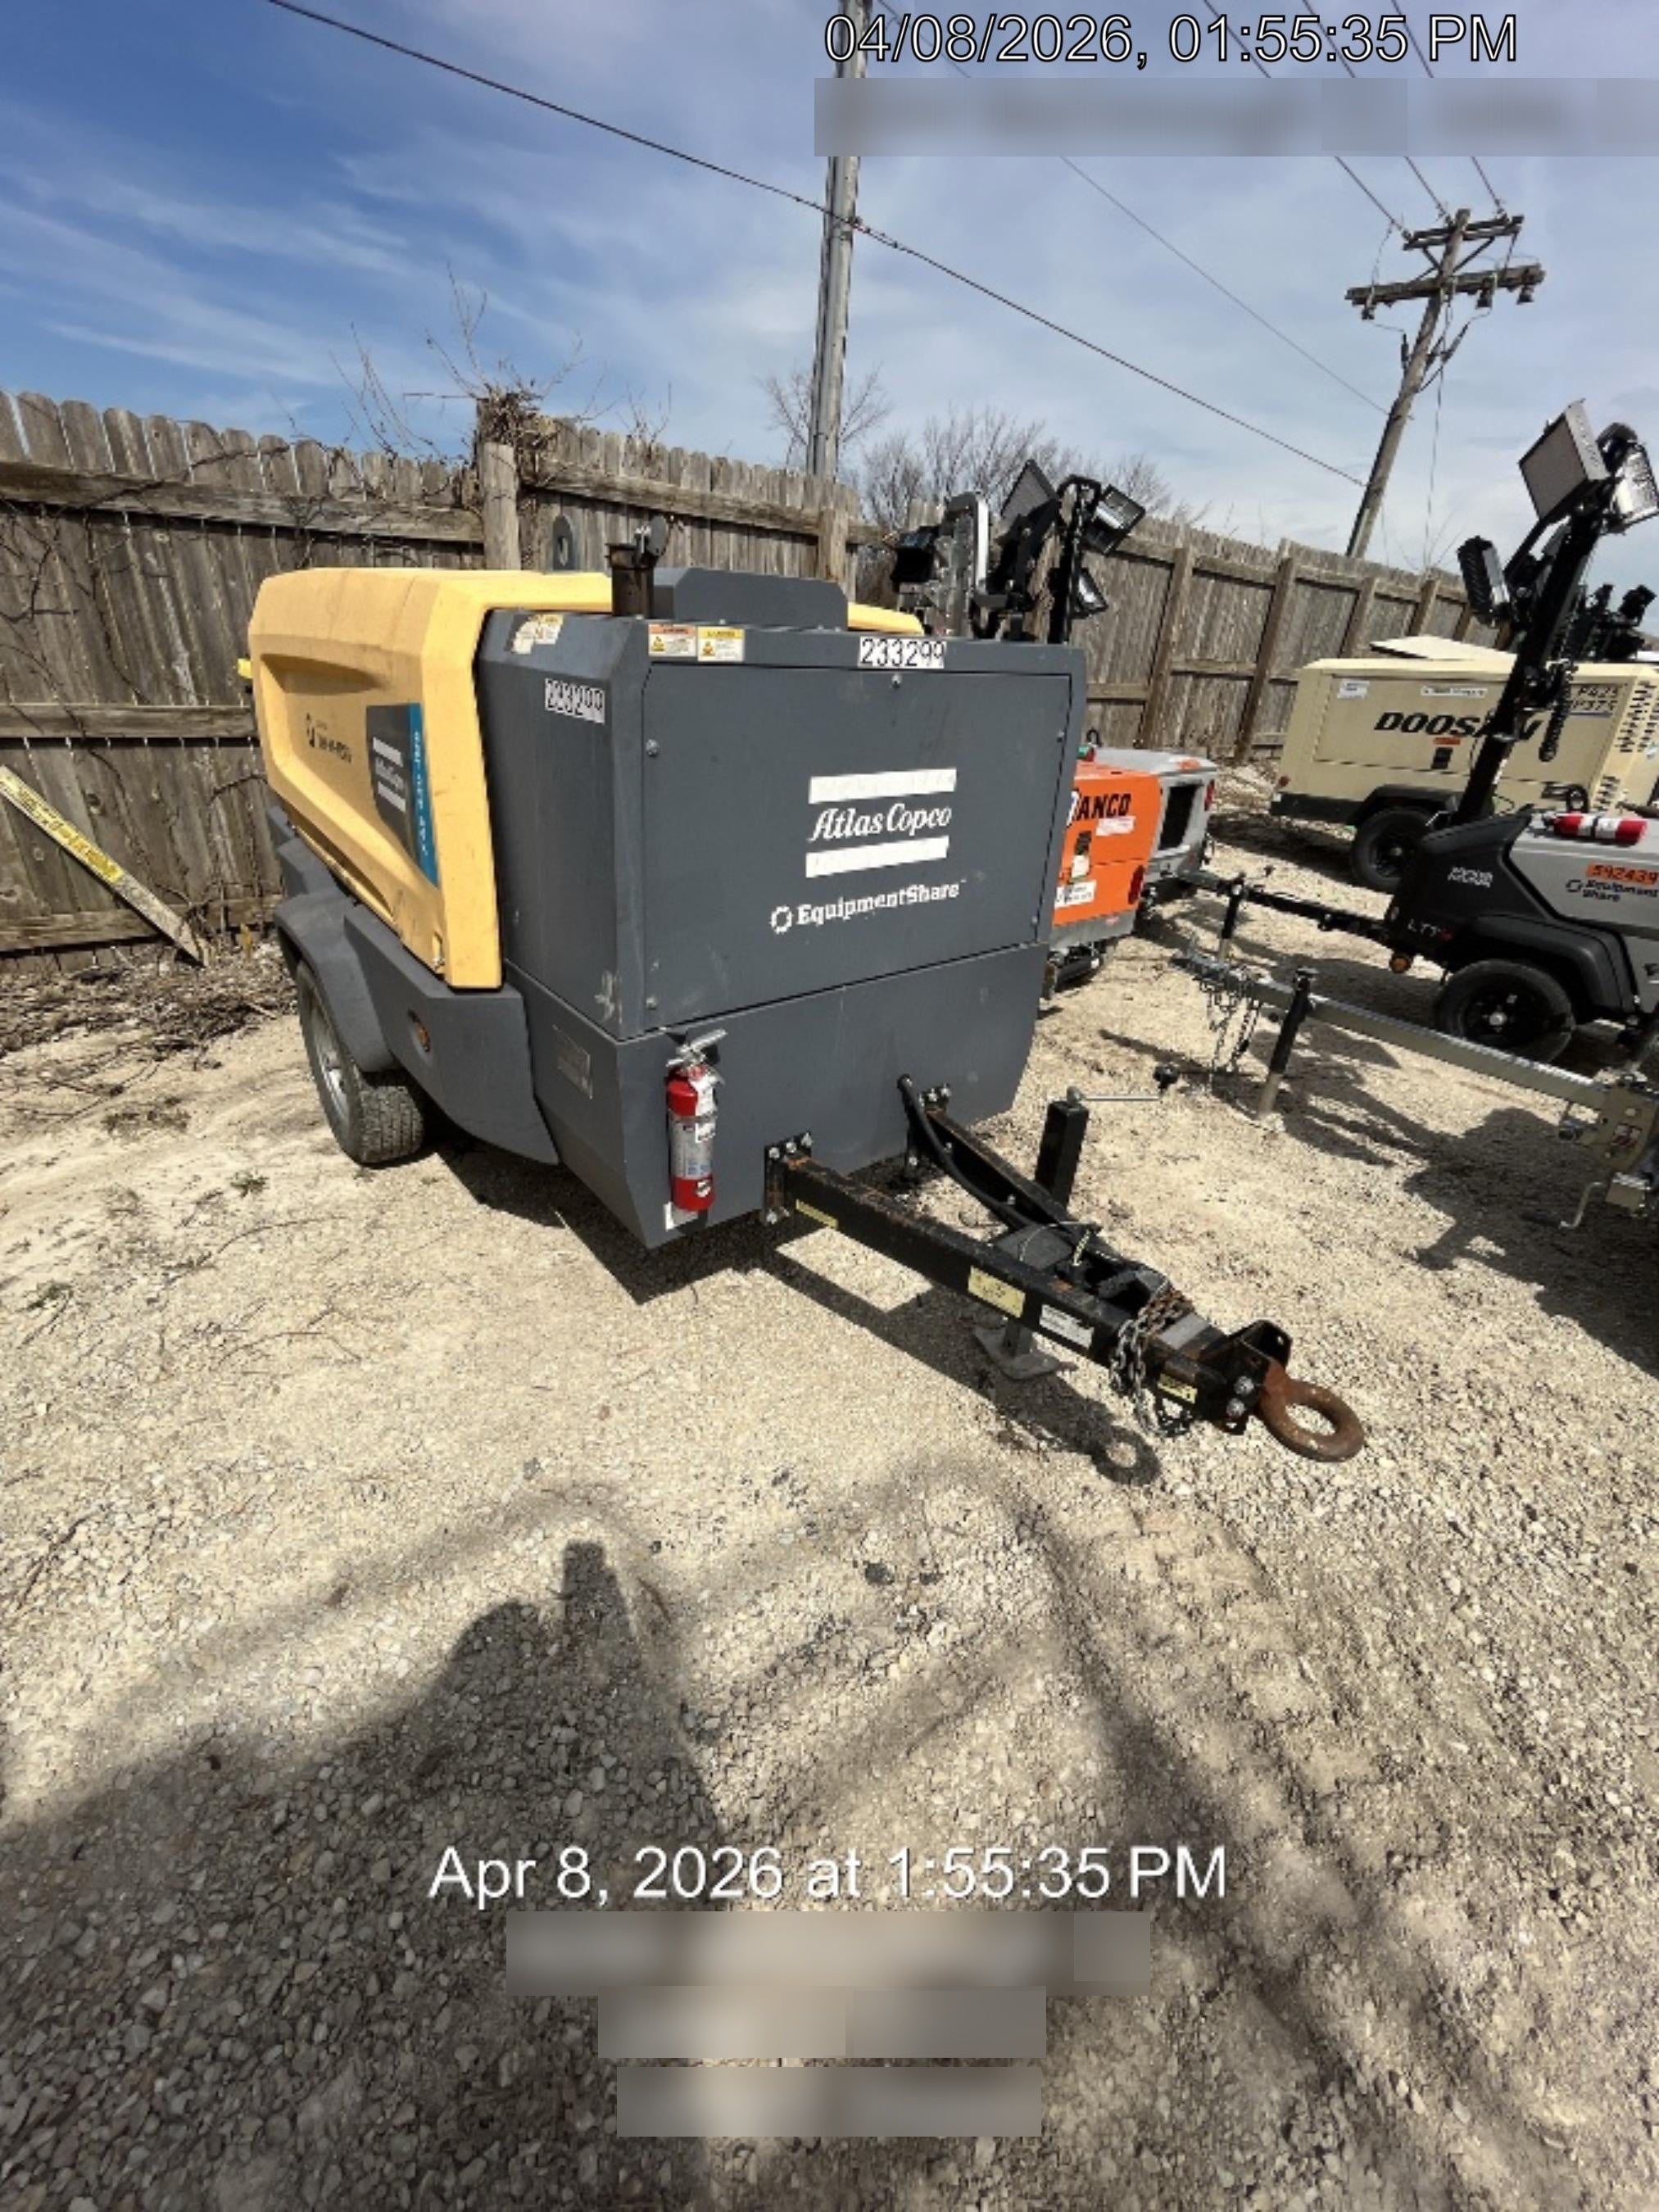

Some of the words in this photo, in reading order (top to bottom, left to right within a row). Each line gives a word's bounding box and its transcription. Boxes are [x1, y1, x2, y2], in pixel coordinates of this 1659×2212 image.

[1374, 711, 1543, 741] DOOS
[806, 807, 884, 844] Atlas
[886, 802, 952, 836] Copco
[1067, 789, 1131, 828] ANCO
[796, 881, 959, 927] EquipmentShare
